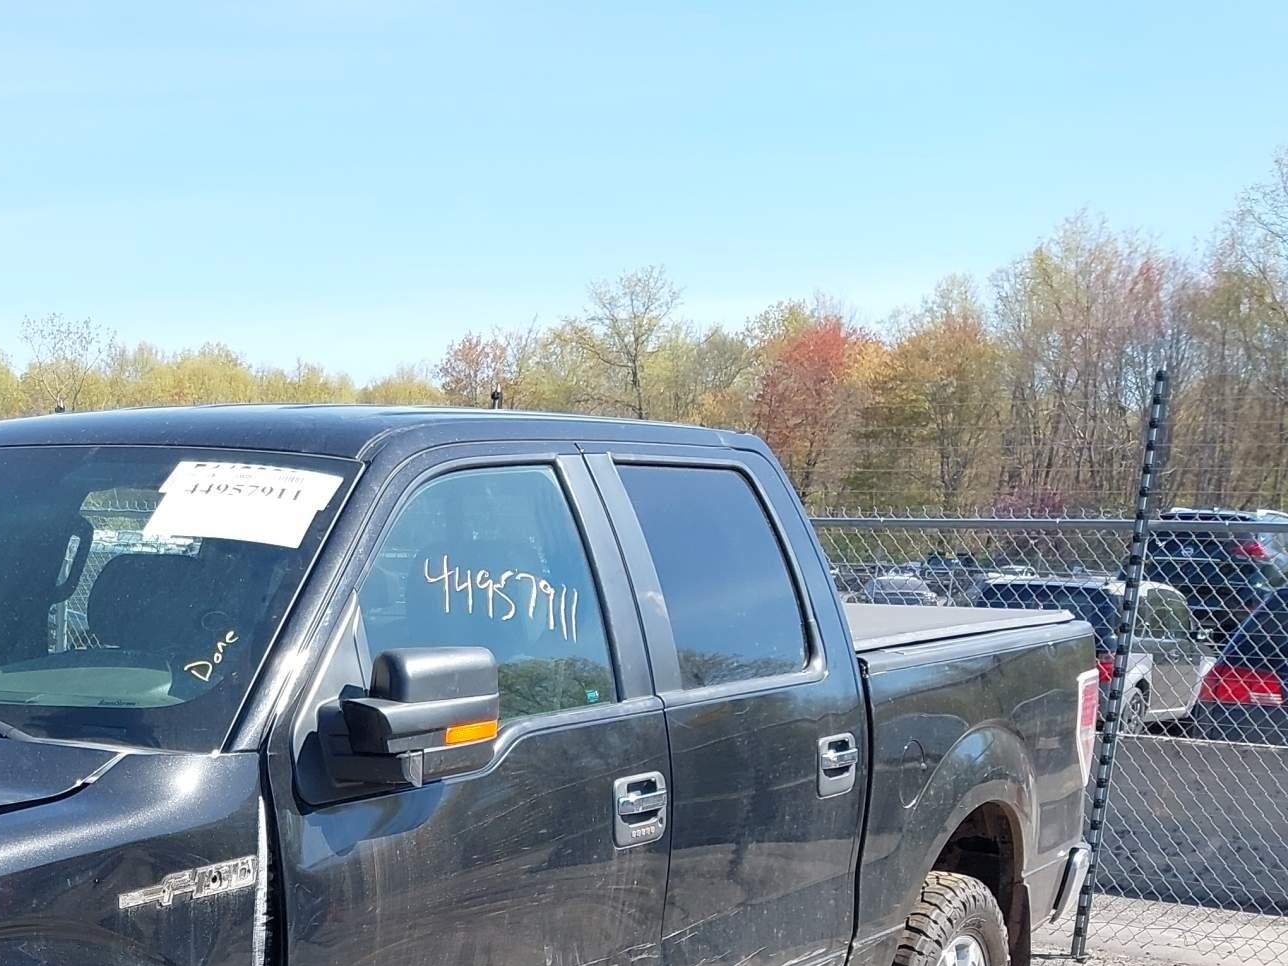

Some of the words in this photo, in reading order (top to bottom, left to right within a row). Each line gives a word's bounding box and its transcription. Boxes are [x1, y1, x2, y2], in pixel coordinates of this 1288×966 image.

[185, 483, 302, 501] 44957911
[424, 554, 578, 643] 44957911
[184, 630, 239, 681] Done
